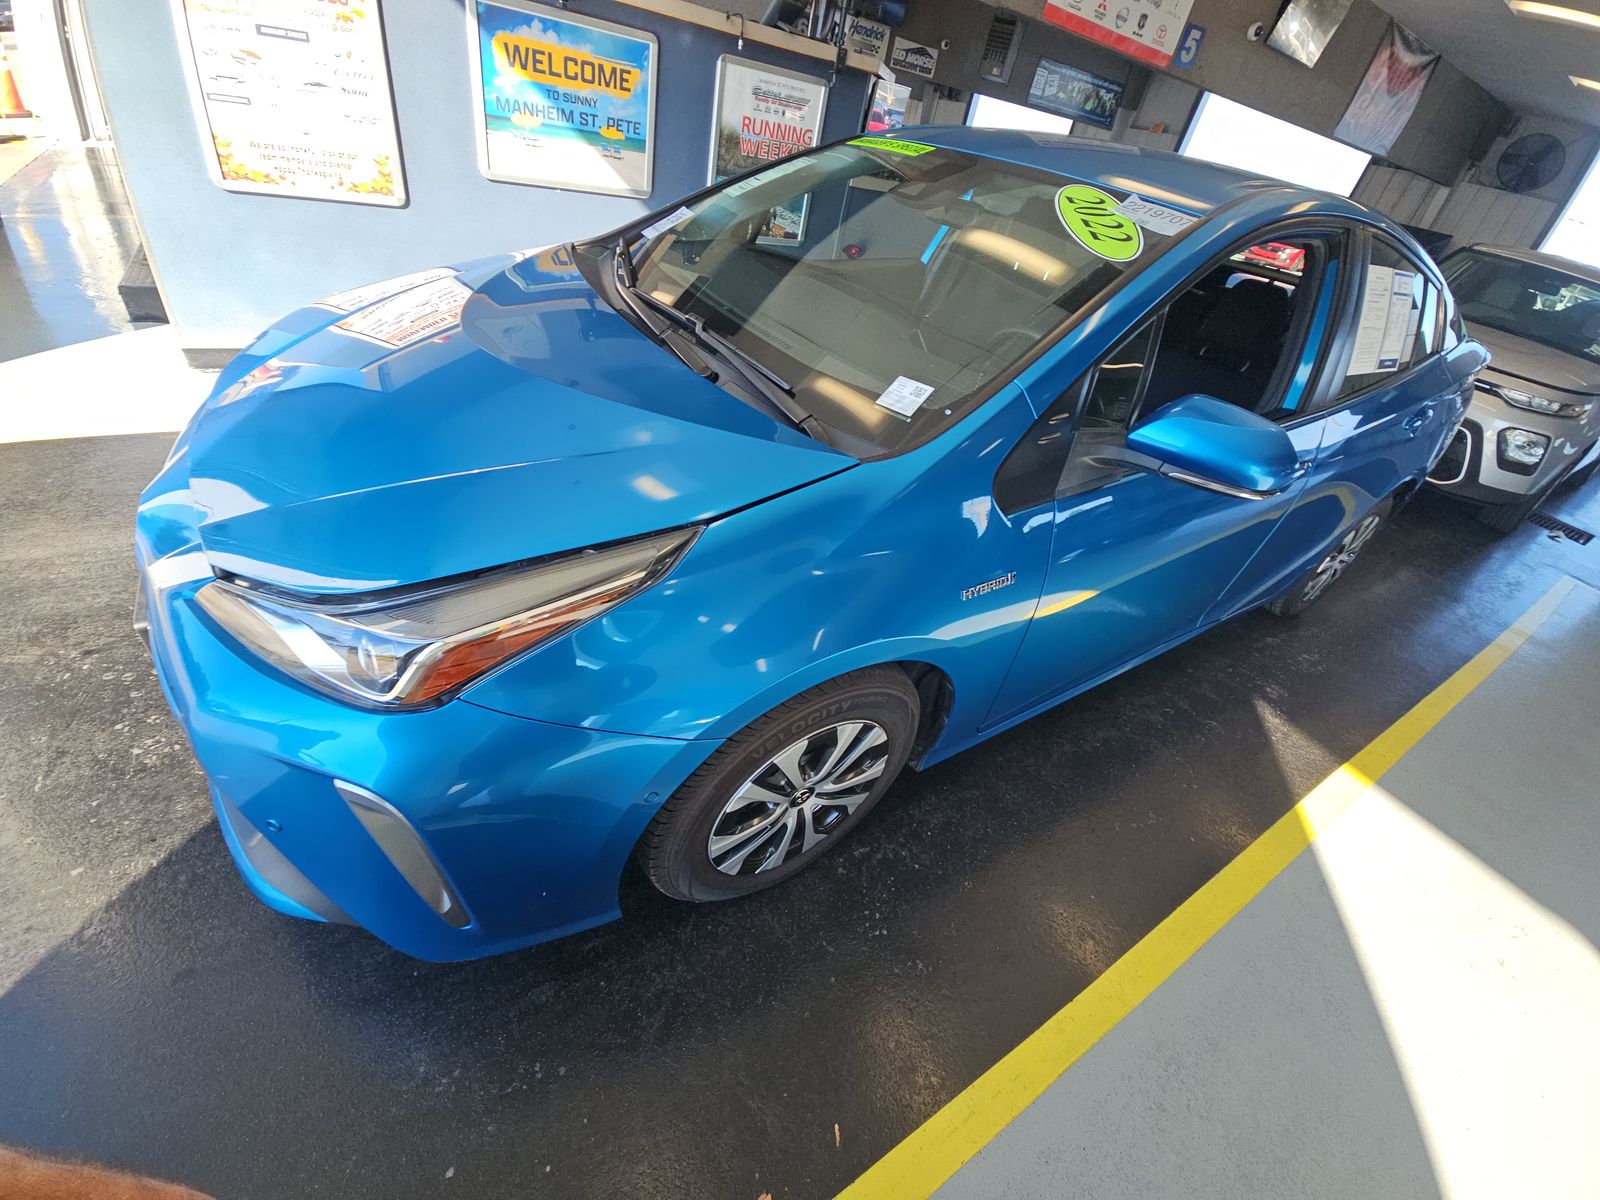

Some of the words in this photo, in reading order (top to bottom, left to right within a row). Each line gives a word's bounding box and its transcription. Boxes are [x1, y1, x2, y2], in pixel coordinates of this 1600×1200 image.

[849, 18, 887, 42] Hendrick
[895, 49, 907, 61] ED
[905, 52, 937, 69] MORSE
[1180, 29, 1202, 64] 5
[502, 41, 632, 93] WELCOME
[545, 88, 560, 101] TO
[562, 92, 599, 109] SUNNY
[495, 95, 575, 125] MANHEIM
[579, 111, 603, 130] ST.
[606, 116, 642, 136] PETE
[741, 115, 814, 146] RUNNING
[1064, 194, 1134, 243] 2022
[1122, 200, 1195, 227] 2219707
[961, 575, 1009, 601] HYBRID
[751, 698, 855, 759] VELOCITY
